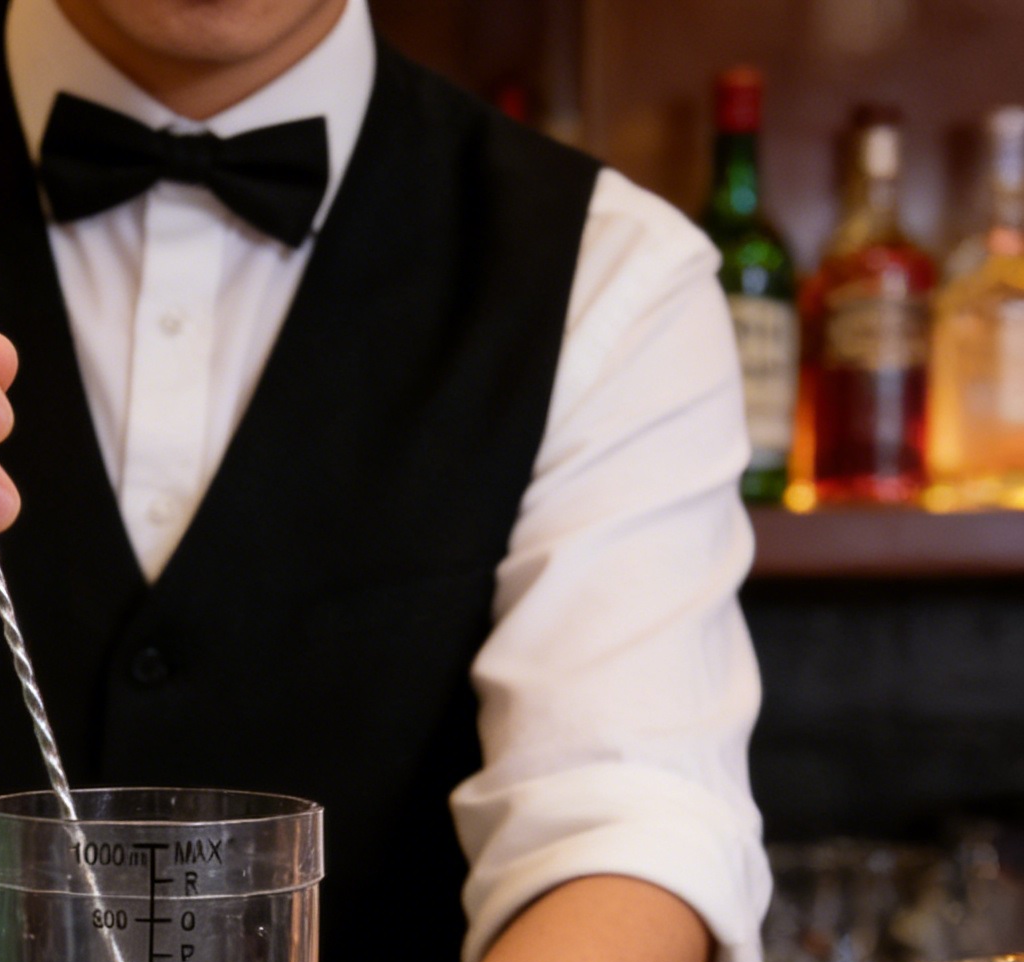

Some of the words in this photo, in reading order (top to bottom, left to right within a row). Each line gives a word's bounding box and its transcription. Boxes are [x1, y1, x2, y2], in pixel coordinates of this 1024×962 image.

[175, 839, 223, 865] MAX
[184, 871, 199, 896] R
[181, 943, 195, 962] P
